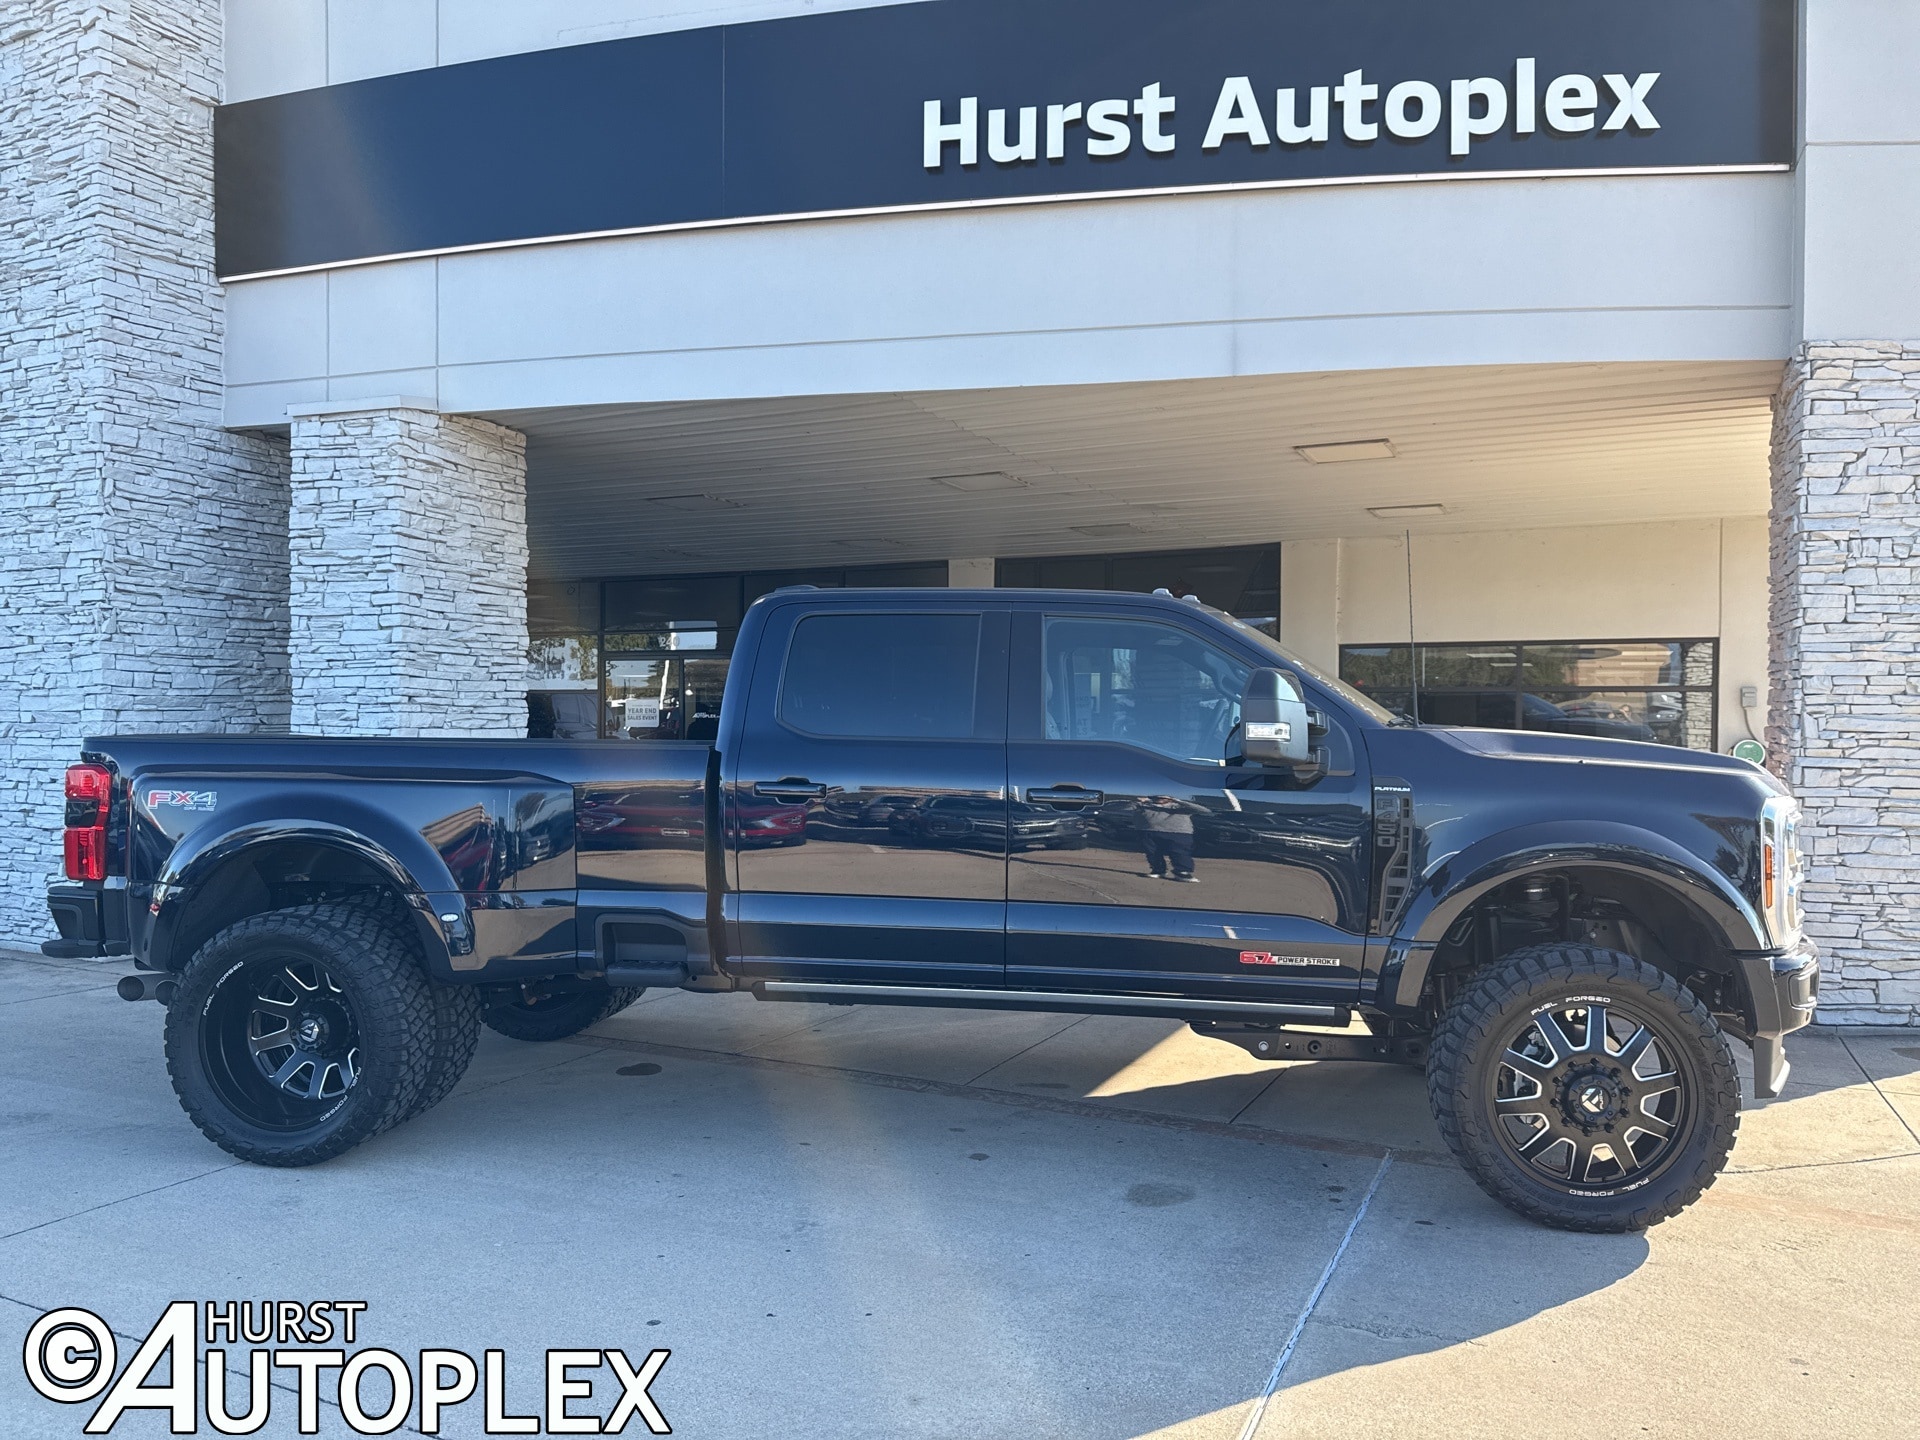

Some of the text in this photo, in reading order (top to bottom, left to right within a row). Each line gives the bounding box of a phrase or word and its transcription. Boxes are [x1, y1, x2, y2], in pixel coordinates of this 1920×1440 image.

[924, 57, 1661, 168] Hurst Autoplex
[148, 790, 217, 809] FX4
[1277, 956, 1306, 964] POWER
[1306, 957, 1338, 966] STROKE
[203, 961, 244, 1016] FUEL FORGED
[1530, 995, 1611, 1016] FUEL FORGED
[319, 1066, 362, 1122] FUEL FORGED
[1569, 1177, 1650, 1197] FUEL FORGED
